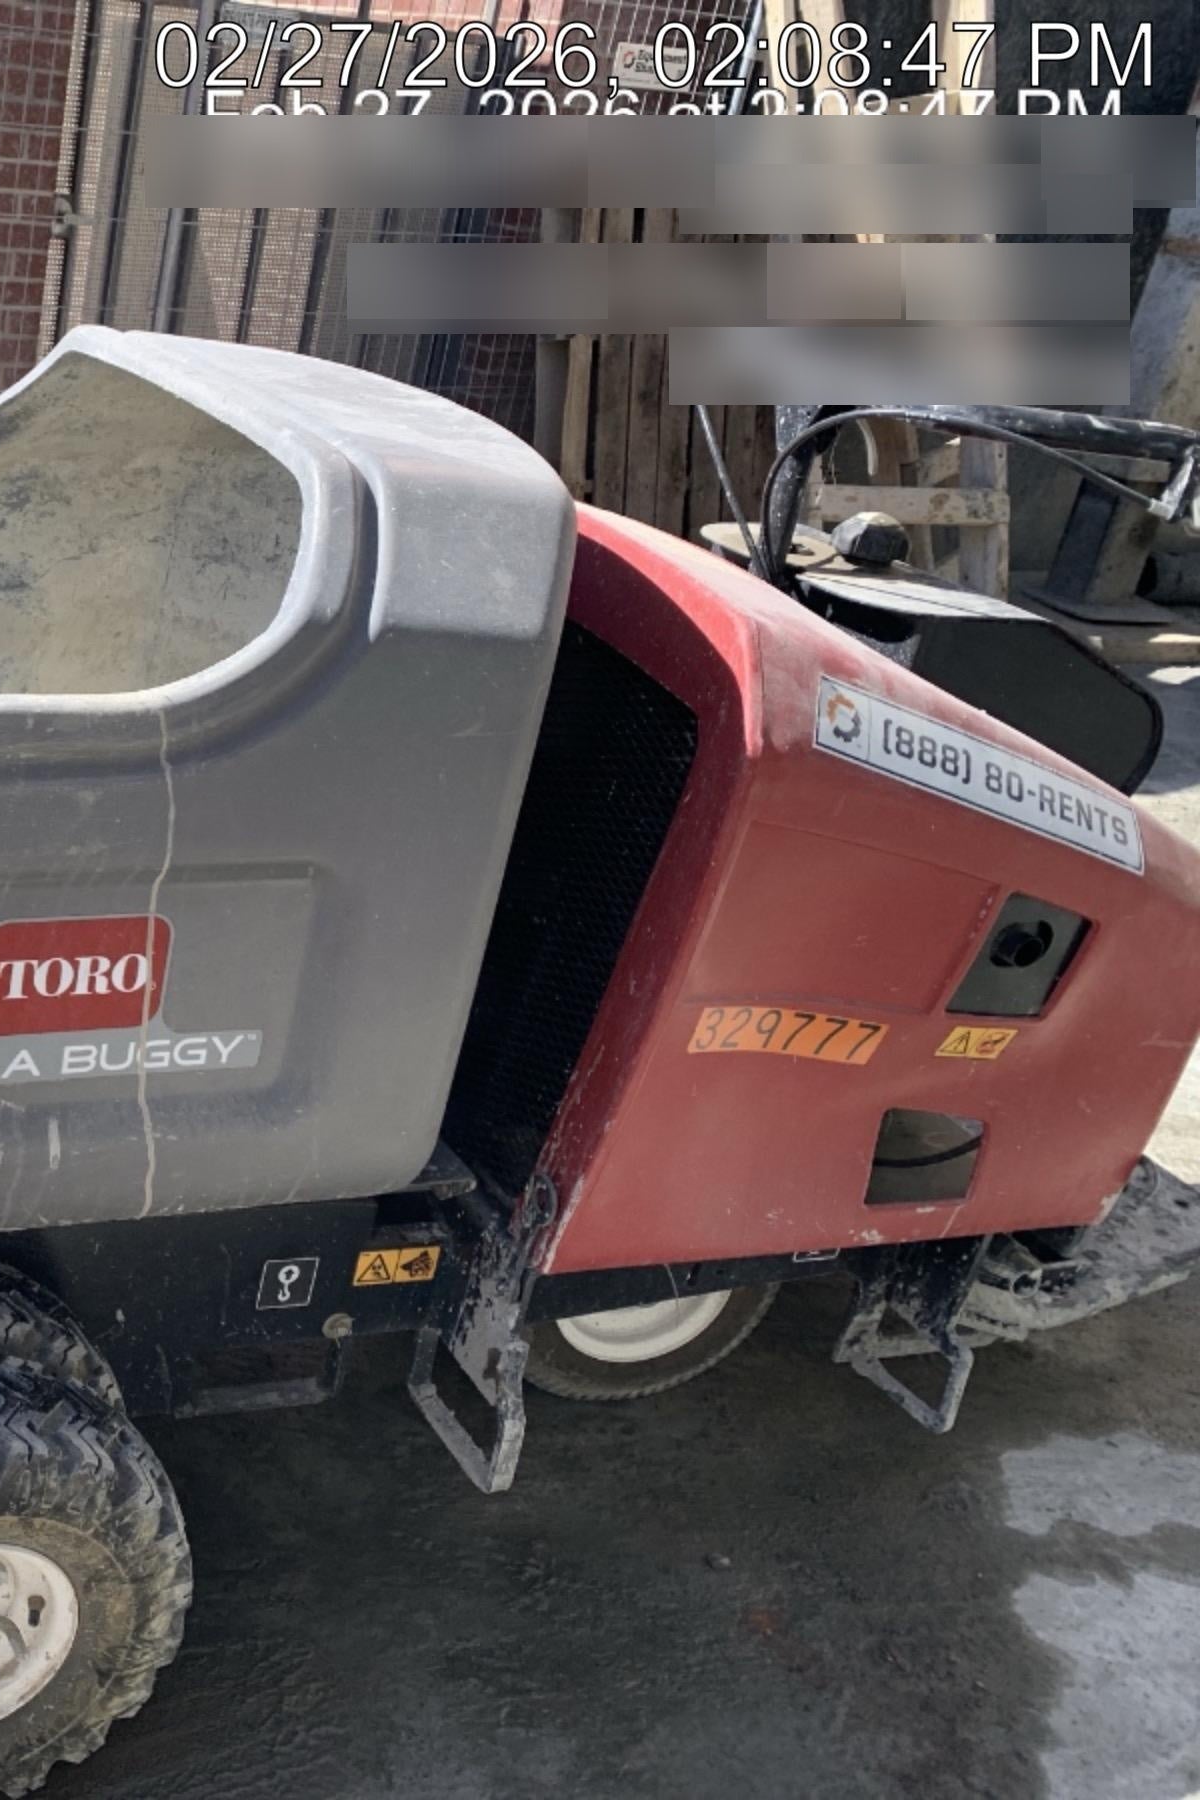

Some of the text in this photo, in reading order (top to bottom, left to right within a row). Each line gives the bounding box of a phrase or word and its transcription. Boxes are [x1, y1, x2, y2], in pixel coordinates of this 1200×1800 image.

[883, 719, 1128, 846] (888) 80-RENTS
[61, 1035, 245, 1075] BUGGY
[695, 1008, 881, 1060] 329777
